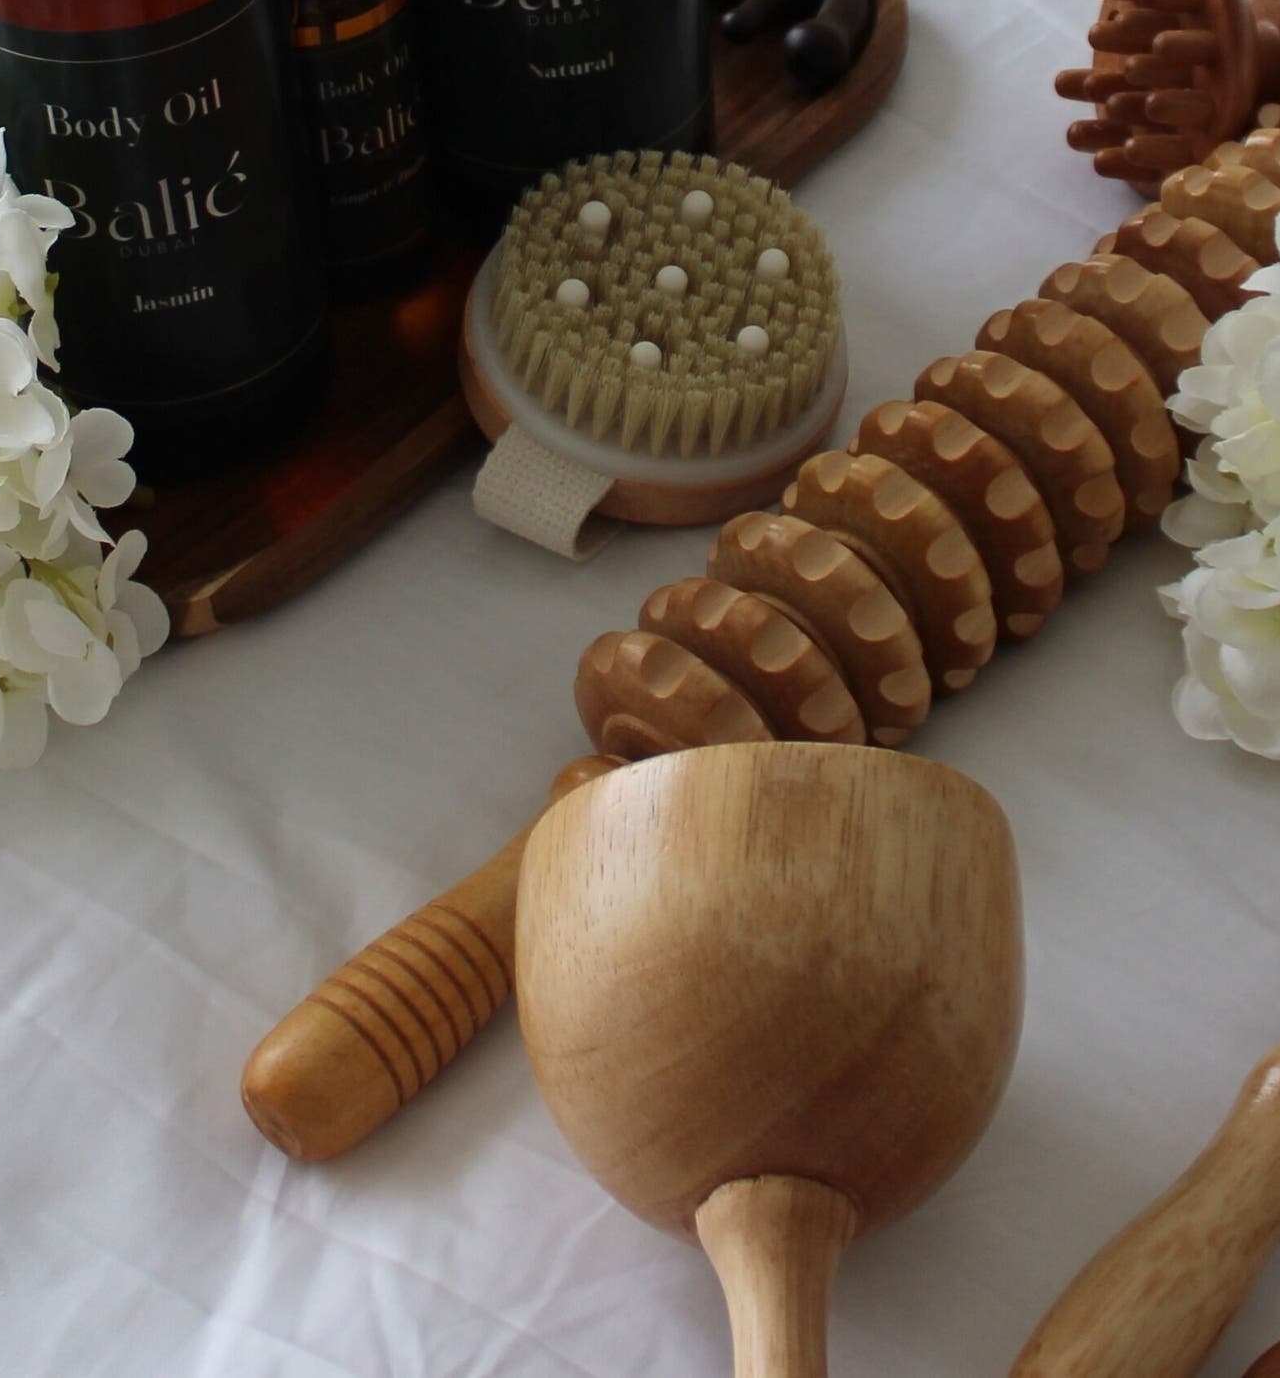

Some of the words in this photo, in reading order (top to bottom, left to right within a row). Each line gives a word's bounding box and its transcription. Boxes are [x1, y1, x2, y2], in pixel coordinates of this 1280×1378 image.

[527, 7, 601, 27] DUBAI
[528, 50, 615, 79] Natural
[44, 103, 145, 147] Body
[163, 78, 221, 126] Oil
[119, 236, 200, 259] DUBAI
[132, 285, 215, 314] Jasmin
